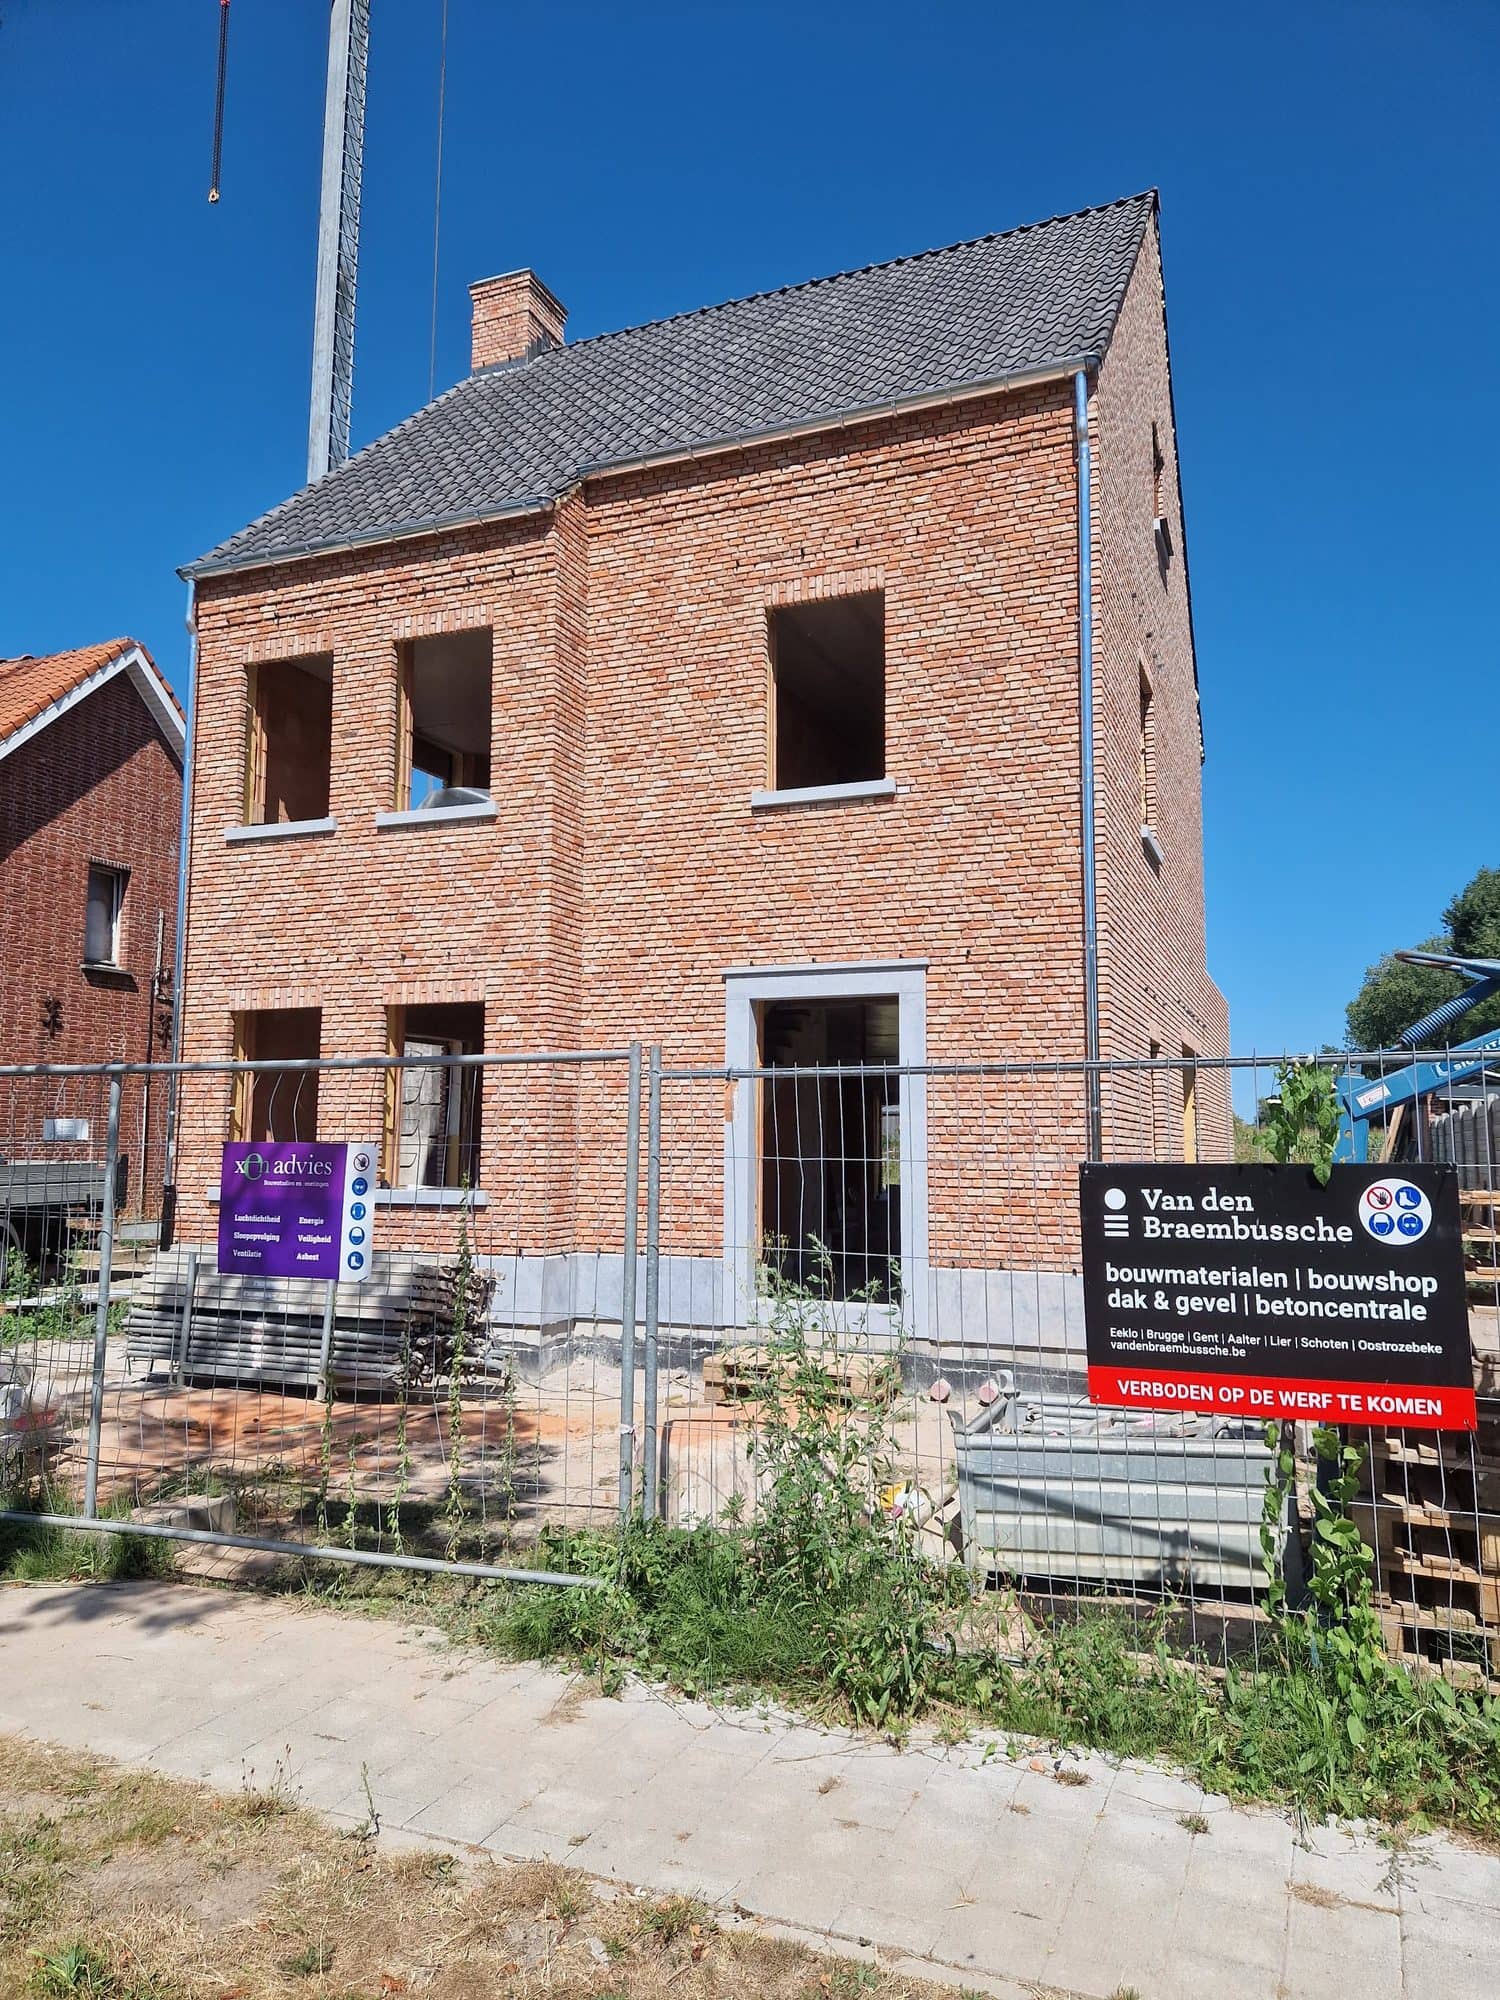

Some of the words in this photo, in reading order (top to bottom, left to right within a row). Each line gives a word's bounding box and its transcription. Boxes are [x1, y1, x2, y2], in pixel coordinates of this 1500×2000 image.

[273, 1153, 333, 1176] advies
[1141, 1188, 1195, 1212] Van
[1201, 1186, 1254, 1212] den
[234, 1213, 281, 1223] Luchtdichtheid
[298, 1216, 325, 1226] Energie
[233, 1231, 280, 1242] Sloopopvolging
[1143, 1215, 1353, 1242] Braembussche
[297, 1234, 332, 1244] Veiligheid
[232, 1249, 262, 1258] Ventilatie
[296, 1252, 320, 1261] Asbest
[1105, 1261, 1288, 1288] bouwmaterialen
[1307, 1267, 1438, 1298] bouwshop
[1107, 1287, 1149, 1309] dak
[1153, 1290, 1170, 1310] &
[1175, 1292, 1237, 1316] gevel
[1255, 1293, 1428, 1321] betoncentrale
[1110, 1327, 1139, 1339] Eeklo
[1146, 1329, 1185, 1343] Brugge
[1192, 1331, 1220, 1344] Gent
[1227, 1333, 1261, 1346] Aalter
[1269, 1335, 1292, 1347] Lier
[1300, 1336, 1349, 1350] Schoten
[1357, 1339, 1443, 1354] Oostrozebeke
[1110, 1340, 1247, 1357] vandenbraembussche.be
[1117, 1379, 1214, 1402] VERBODEN
[1218, 1387, 1245, 1403] OP
[1250, 1389, 1275, 1406] DE
[1278, 1390, 1333, 1409] WERF
[1336, 1393, 1363, 1411] TE
[1367, 1395, 1443, 1416] KOMEN
